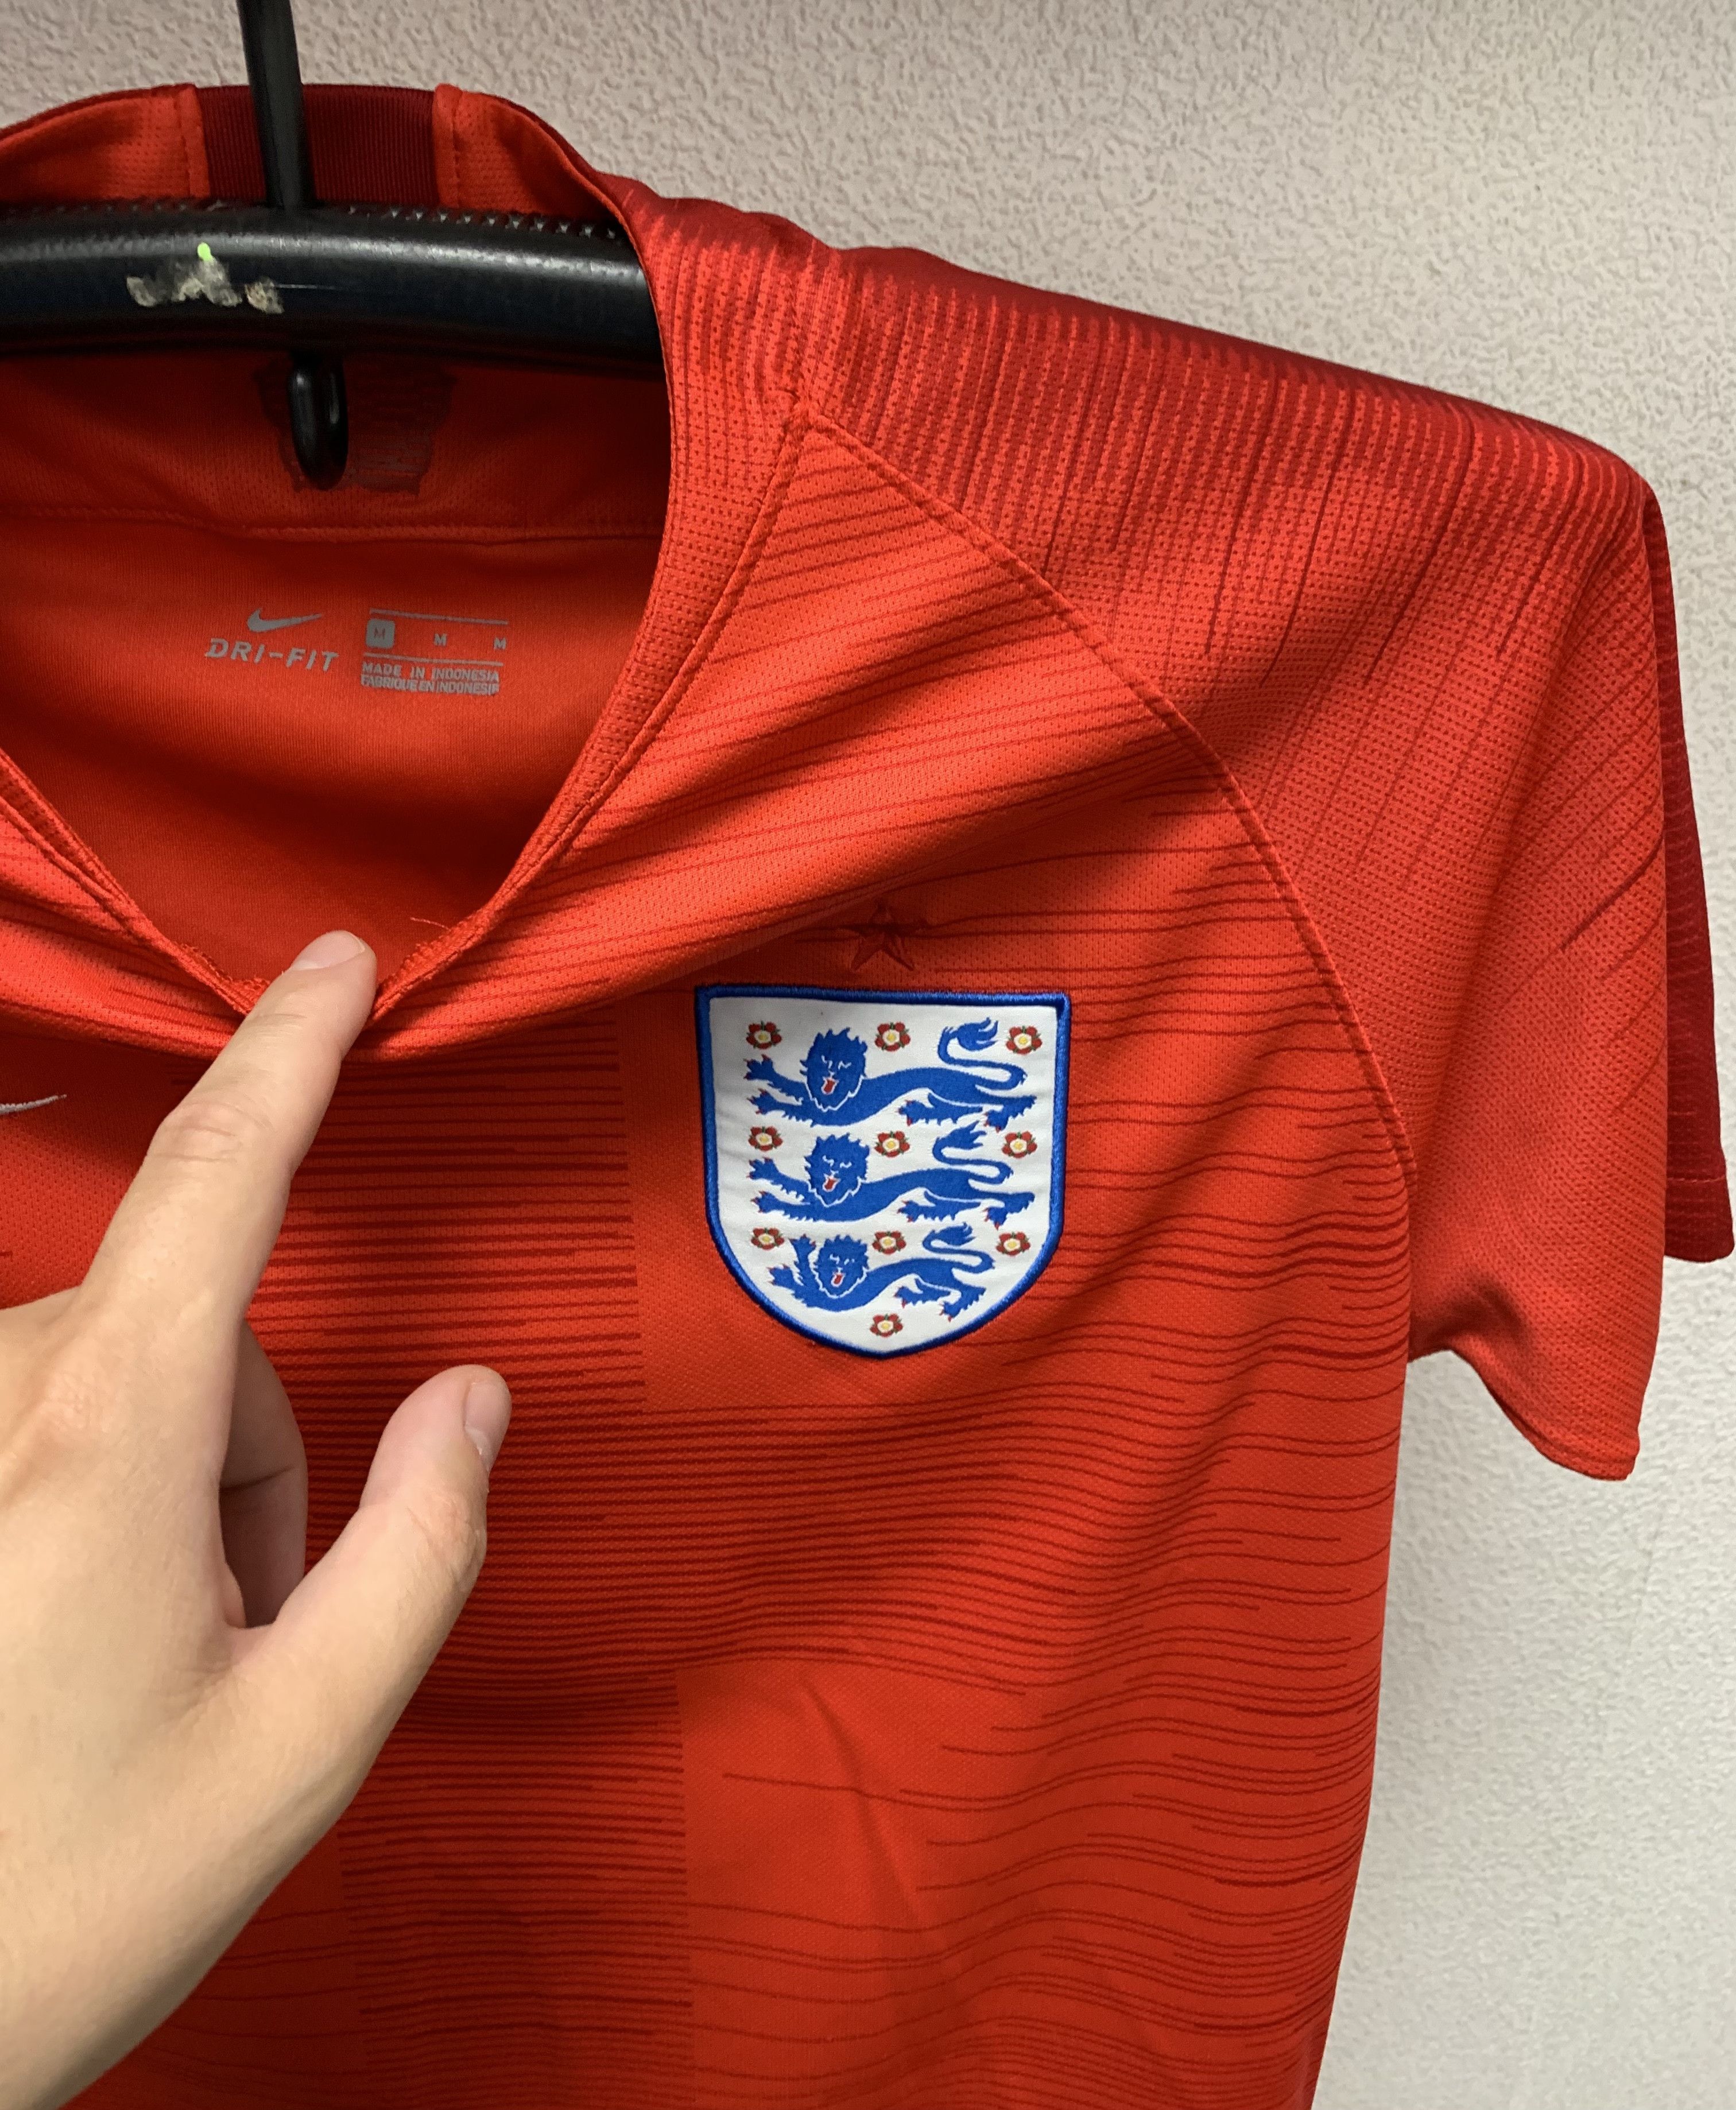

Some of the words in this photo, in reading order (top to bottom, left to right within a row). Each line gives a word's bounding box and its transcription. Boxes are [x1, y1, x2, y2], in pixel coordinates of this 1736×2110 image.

[373, 627, 386, 640] M
[433, 633, 447, 646] M
[493, 637, 507, 650] M
[205, 638, 340, 672] DRI-FIT
[361, 674, 418, 692] FABRIQUE
[418, 680, 435, 693] EN
[362, 662, 402, 677] MADE
[410, 666, 426, 680] IN
[432, 668, 499, 683] INDONESIA
